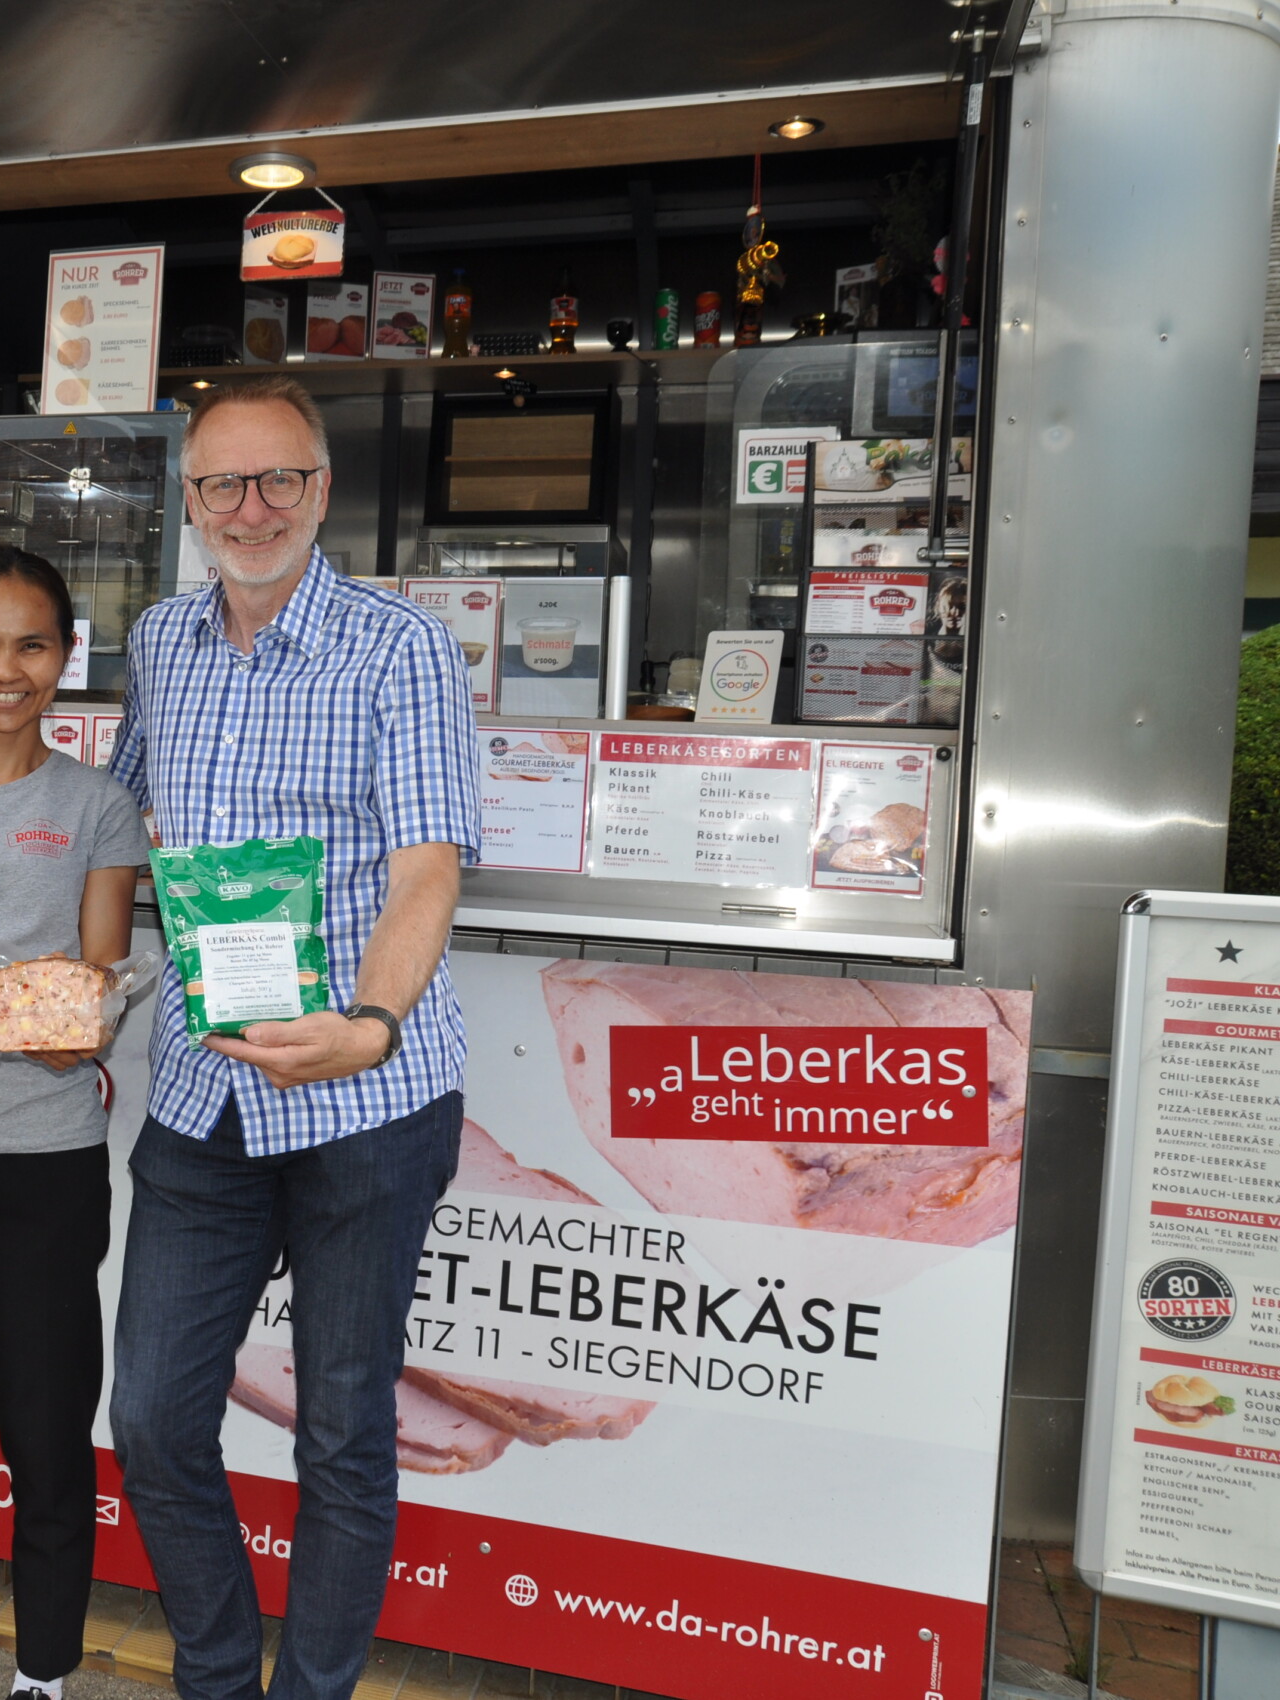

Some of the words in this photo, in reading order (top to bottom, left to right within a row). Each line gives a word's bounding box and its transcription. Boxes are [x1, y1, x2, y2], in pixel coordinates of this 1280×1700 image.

[250, 218, 341, 239] WELTKULTURERBE
[61, 266, 99, 283] NUR
[873, 596, 910, 606] ROHRER
[527, 639, 571, 650] Schmalz
[716, 678, 760, 692] Google
[610, 741, 801, 762] LEBERKÄSESORTEN
[492, 758, 575, 769] GOURMET-LEBERKÄSE
[840, 760, 885, 770] REGENTE
[609, 767, 657, 778] Klassik
[701, 772, 732, 782] Chili
[608, 782, 650, 793] Pikant
[699, 787, 771, 800] Chili-Käse
[607, 804, 638, 813] Käse
[699, 809, 770, 821] Knoblauch
[606, 825, 649, 836] Pferde
[697, 830, 780, 843] Röstzwiebel
[15, 830, 69, 847] ROHRER
[604, 844, 650, 856] Bauern
[696, 850, 732, 861] Pizza
[222, 885, 249, 893] KAVO
[1208, 1002, 1272, 1015] LEBERKÄSE
[1162, 1040, 1225, 1052] LEBERKÄSE
[1230, 1045, 1274, 1056] PIKANT
[691, 1033, 967, 1086] Leberkas
[1161, 1055, 1260, 1071] KÄSE-LEBERKÄSE
[1160, 1071, 1260, 1087] CHILI-LEBERKÄSE
[691, 1089, 765, 1123] geht
[1157, 1104, 1262, 1120] PIZZA-LEBERKÄSE
[1156, 1128, 1274, 1147] BAUERN-LEBERKÄSE
[1154, 1151, 1267, 1170] PFERDE-LEBERKÄSE
[1186, 1207, 1265, 1225] SAISONALE
[432, 1204, 686, 1265] GEMACHTER
[1149, 1221, 1209, 1235] SAISONAL
[1168, 1276, 1199, 1297] 80
[1145, 1298, 1231, 1317] SORTEN
[474, 1326, 502, 1361] 11
[548, 1337, 824, 1405] SIEGENDORF
[1144, 1464, 1183, 1476] KETCHUP
[1143, 1477, 1199, 1491] ENGLISCHER
[1141, 1501, 1195, 1516] PFEFFERONI
[1140, 1514, 1193, 1528] PFEFFERONI
[1196, 1524, 1233, 1535] SCHARF
[1125, 1549, 1143, 1558] Infos
[1156, 1554, 1170, 1563] den
[1172, 1557, 1214, 1571] Allergenen
[1215, 1563, 1231, 1574] bitte
[1234, 1567, 1253, 1578] beim
[1179, 1570, 1195, 1579] Alle
[1197, 1573, 1221, 1584] Preise
[554, 1589, 886, 1673] www.da-rohrer.at
